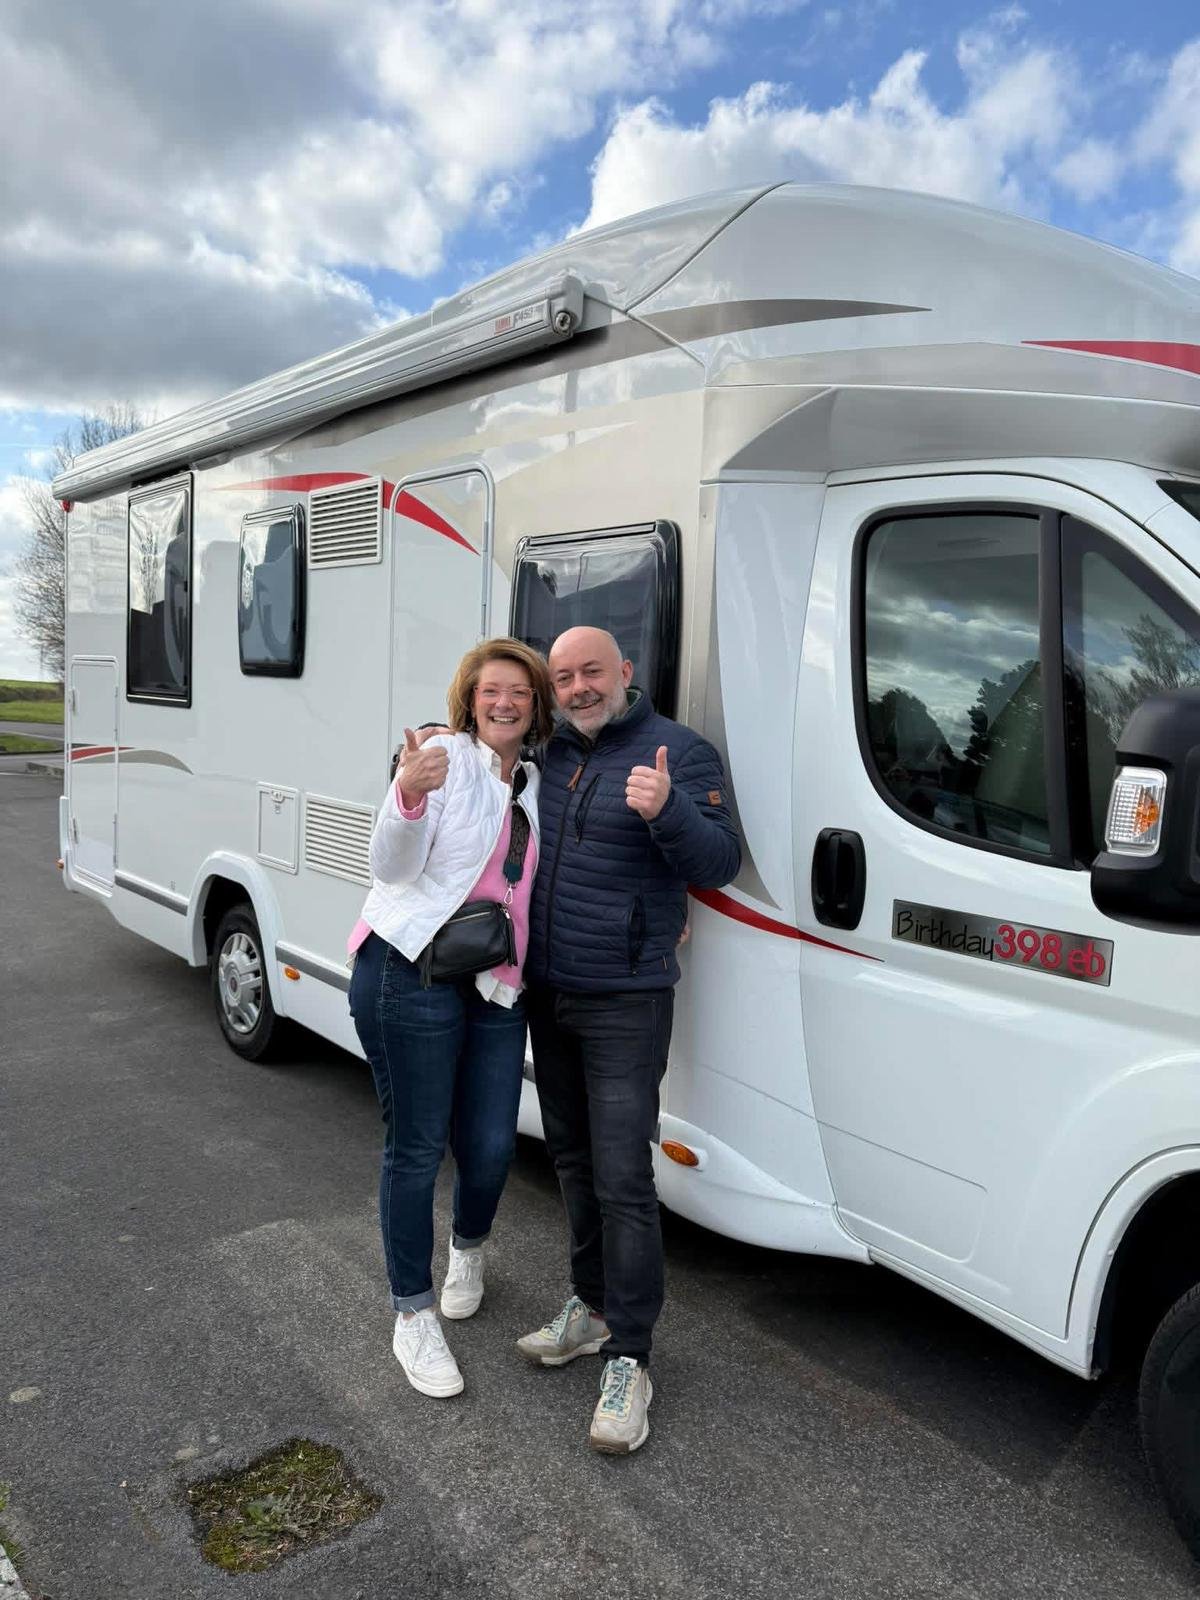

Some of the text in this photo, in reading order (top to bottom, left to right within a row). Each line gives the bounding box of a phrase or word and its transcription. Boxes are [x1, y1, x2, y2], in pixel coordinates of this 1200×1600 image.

[896, 910, 1106, 977] Birthday 398 eb
